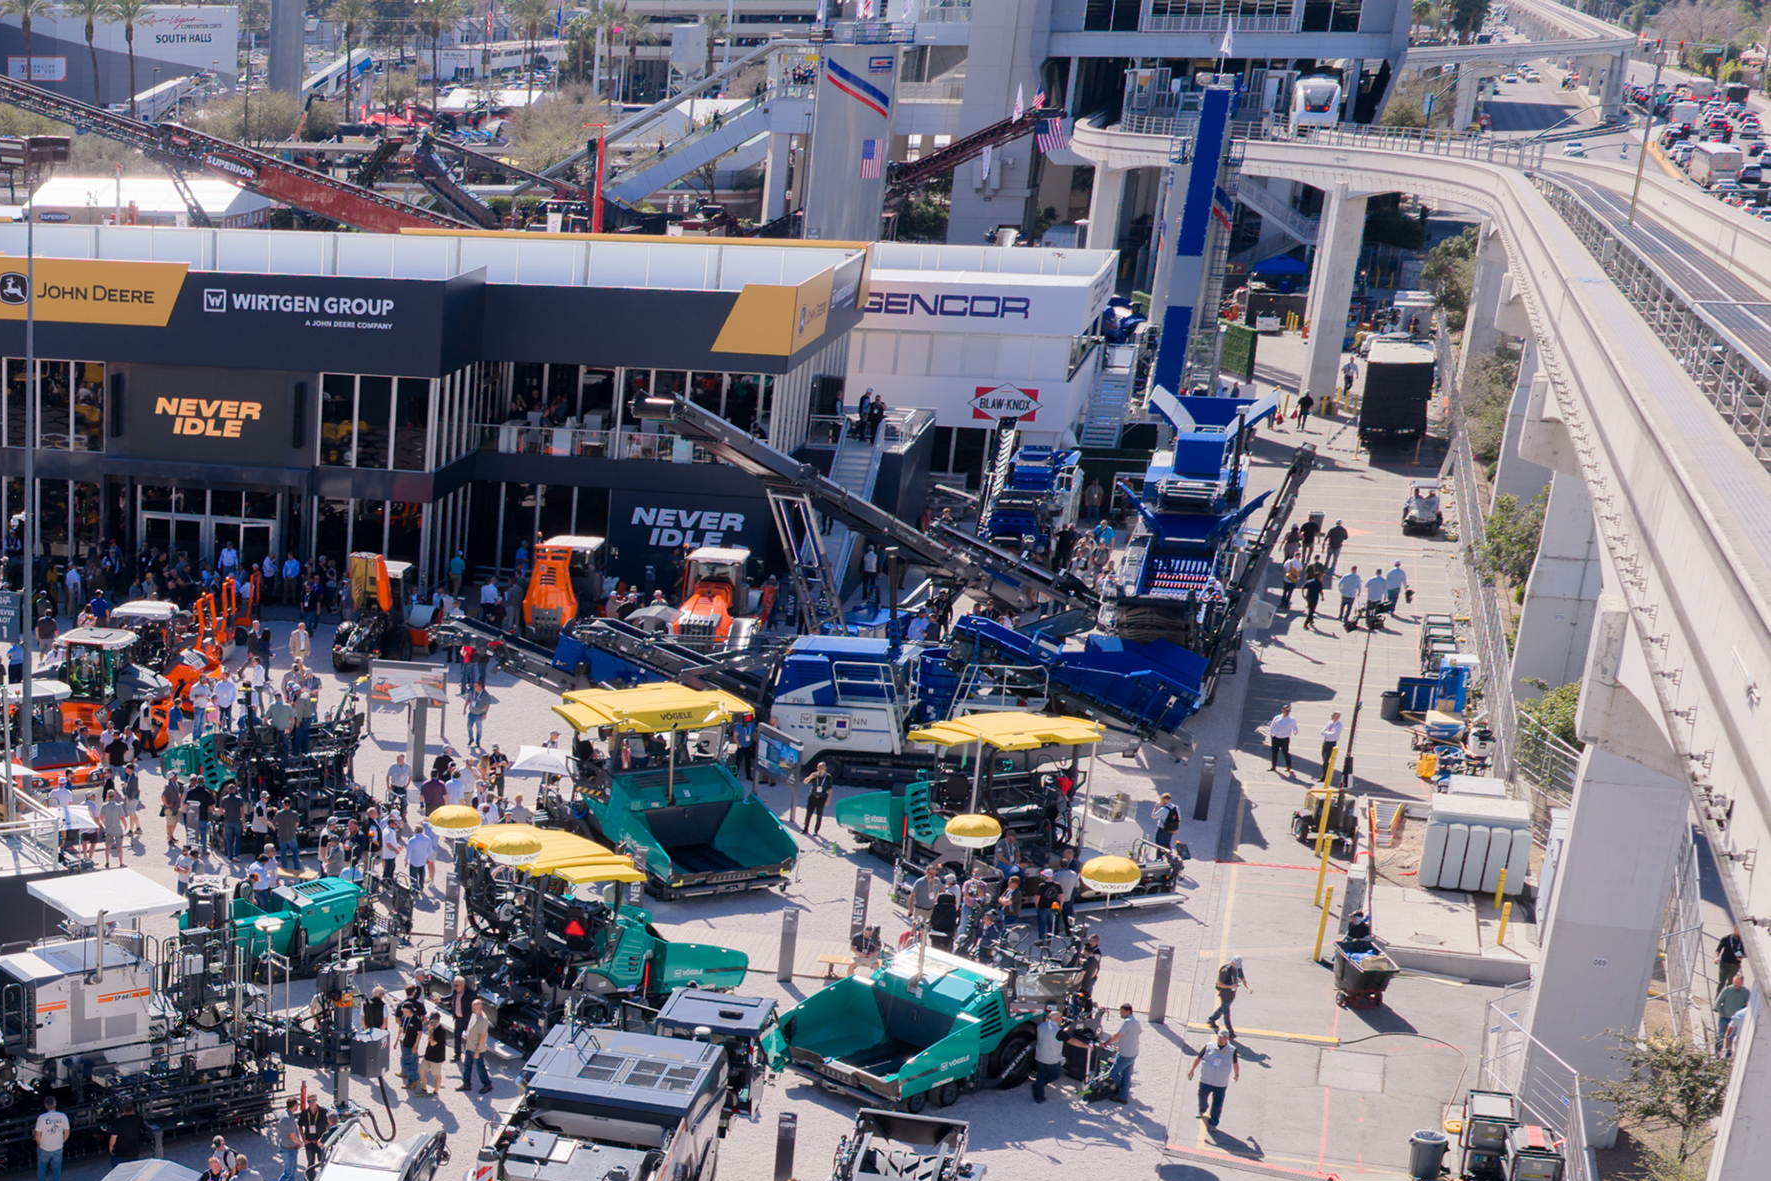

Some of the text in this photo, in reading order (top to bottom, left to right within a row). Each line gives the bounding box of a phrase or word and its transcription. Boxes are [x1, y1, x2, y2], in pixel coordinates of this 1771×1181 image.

[155, 33, 212, 44] SOUTH HALLS
[206, 155, 255, 178] SUPERIOR
[40, 213, 70, 221] SUPERIOR
[37, 282, 155, 304] JOHN DEERE
[232, 293, 320, 313] WIRTGEN
[324, 297, 395, 316] GROUP
[863, 292, 1031, 320] GENCOR
[312, 320, 332, 328] JOHN
[333, 321, 356, 329] DEERE
[357, 321, 393, 330] COMPANY
[155, 397, 262, 420] NEVER
[979, 397, 1031, 412] BLAW-KNOX
[173, 417, 243, 438] IDLE
[631, 507, 745, 532] NEVER
[649, 528, 724, 549] IDLE
[0, 616, 10, 624] LOT
[1, 626, 8, 639] 1
[660, 711, 693, 721] VÖGELE
[445, 901, 456, 929] NEW
[852, 896, 865, 926] NEW
[683, 968, 703, 977] VÖGELE
[949, 1054, 970, 1067] VÖGELE
